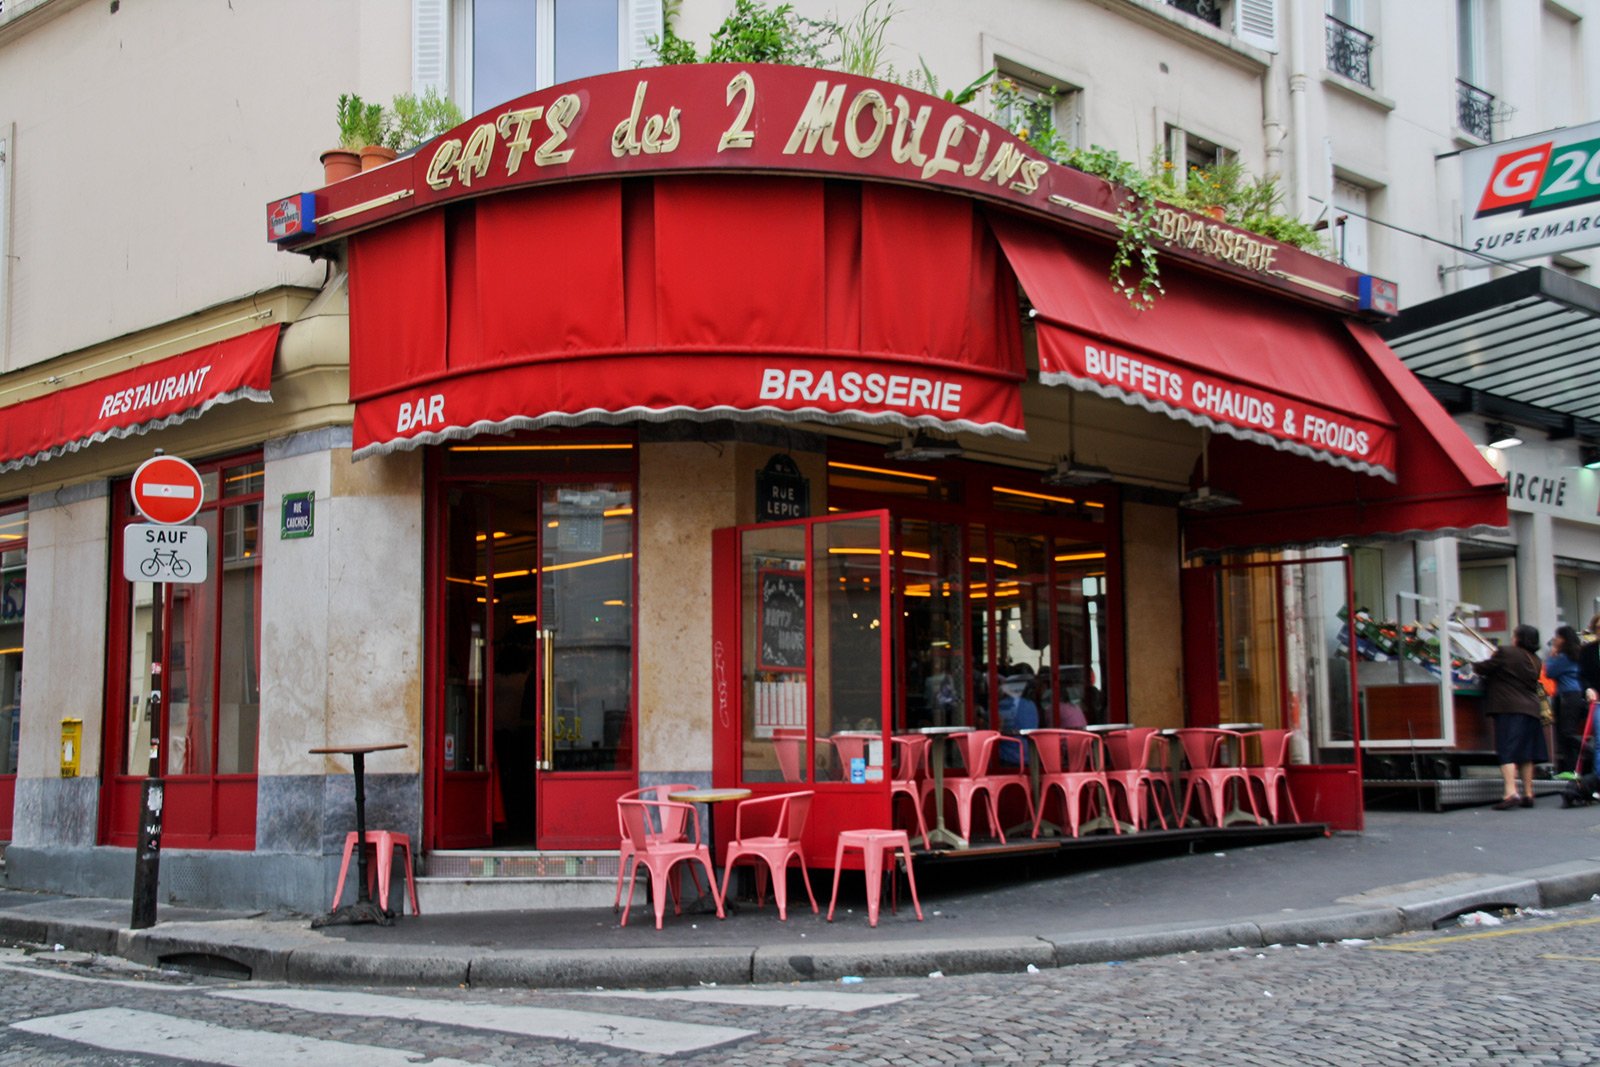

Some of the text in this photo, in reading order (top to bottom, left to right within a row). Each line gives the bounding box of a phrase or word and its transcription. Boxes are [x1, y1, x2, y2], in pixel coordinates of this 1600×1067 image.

[611, 80, 682, 158] des
[717, 70, 756, 153] 2
[782, 80, 1049, 195] MOULINS
[1159, 208, 1279, 274] BRASSERIE
[98, 365, 211, 420] RESTAURANT
[759, 368, 962, 413] BRASSERIE
[1084, 345, 1369, 455] BUFFETS CHAUDS & FROIDS
[397, 394, 445, 433] BAR
[293, 502, 302, 514] RUE
[767, 501, 800, 517] LEPIC
[772, 485, 795, 501] RUE
[145, 529, 188, 543] SAUF
